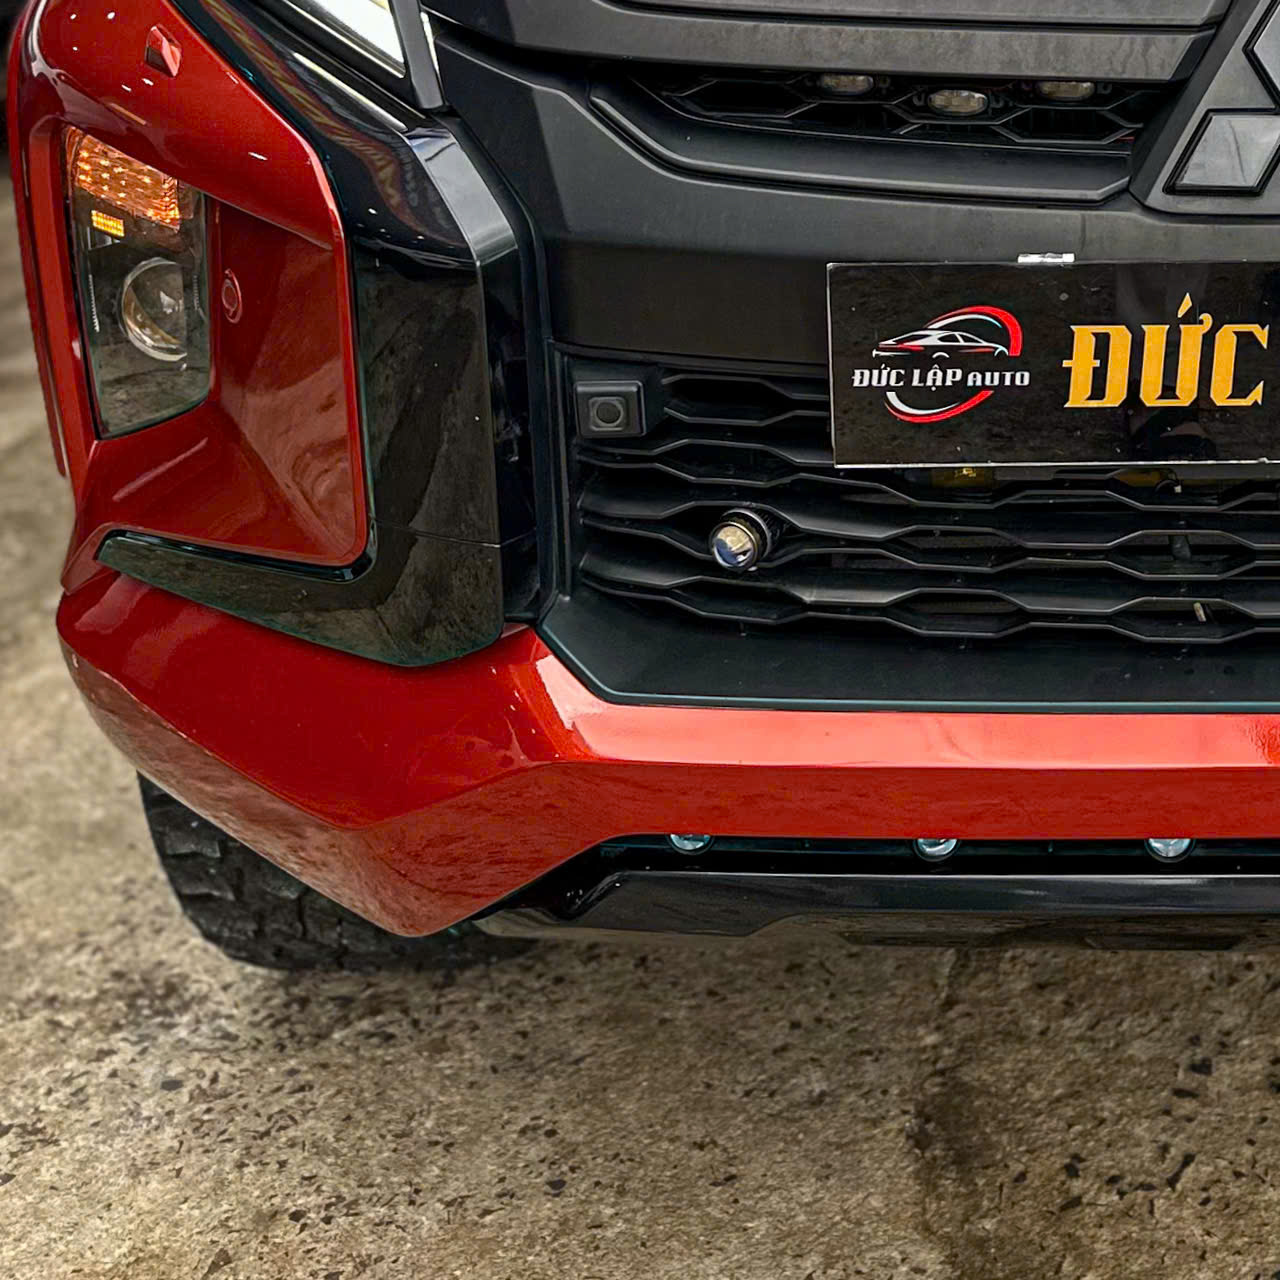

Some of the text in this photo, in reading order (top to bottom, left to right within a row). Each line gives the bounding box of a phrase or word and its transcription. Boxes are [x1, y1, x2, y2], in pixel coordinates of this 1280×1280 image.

[851, 363, 1031, 392] ĐỨC LẬP AUTO
[1061, 293, 1269, 409] ĐỨC
